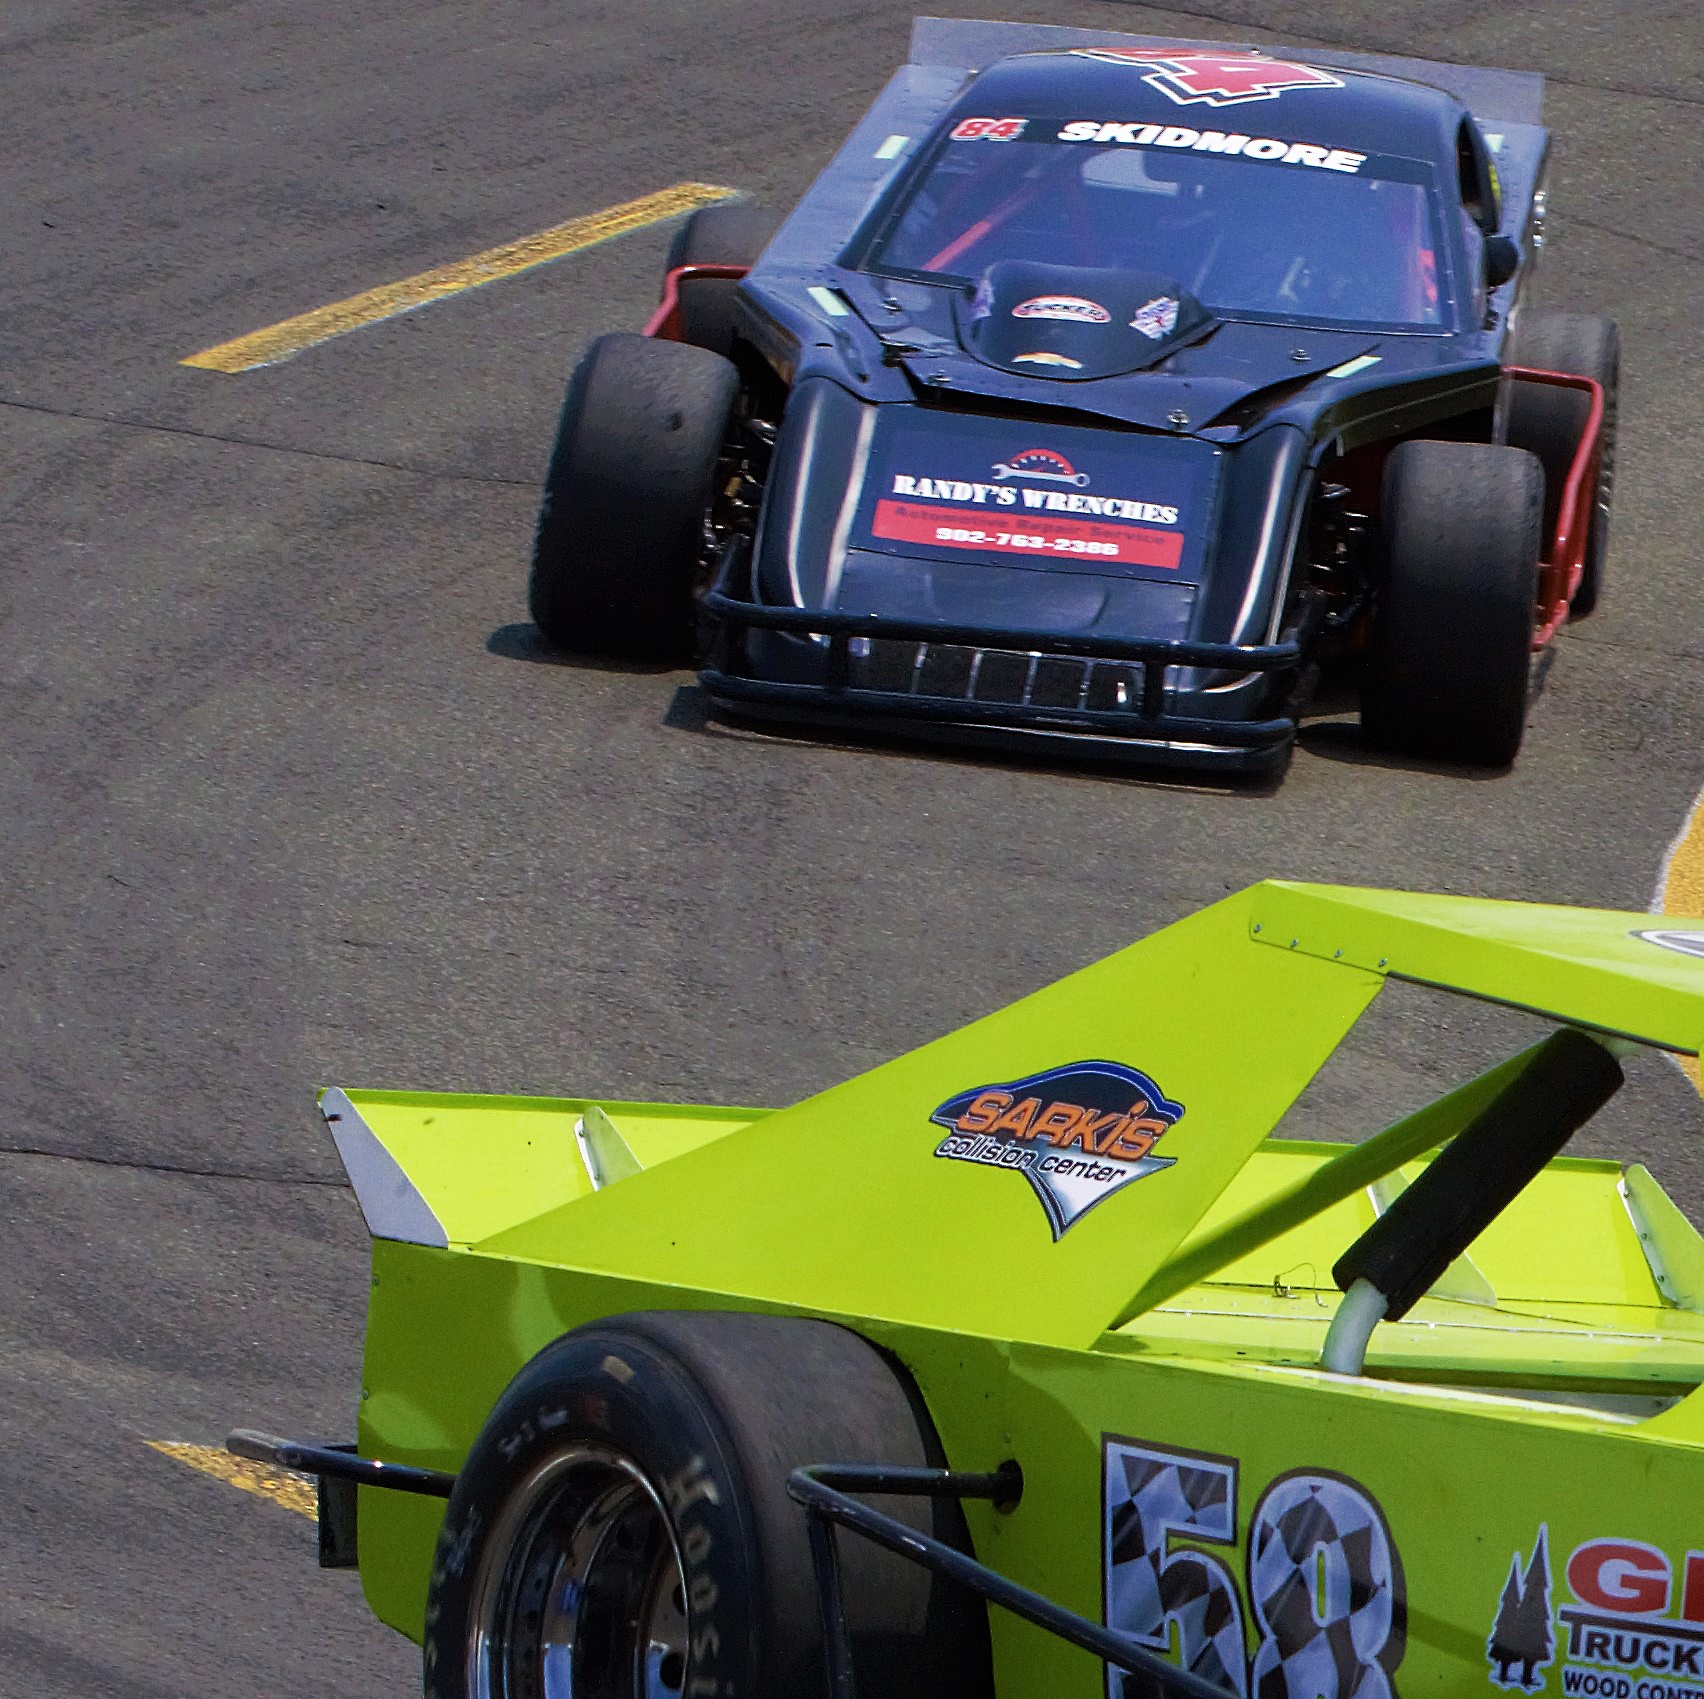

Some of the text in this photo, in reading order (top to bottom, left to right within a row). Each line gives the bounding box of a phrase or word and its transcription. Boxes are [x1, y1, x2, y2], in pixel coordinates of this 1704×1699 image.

[950, 117, 1367, 173] 84 SKIDMORE
[892, 474, 1178, 525] RANDY'S WRENCHES
[1039, 1152, 1129, 1183] center
